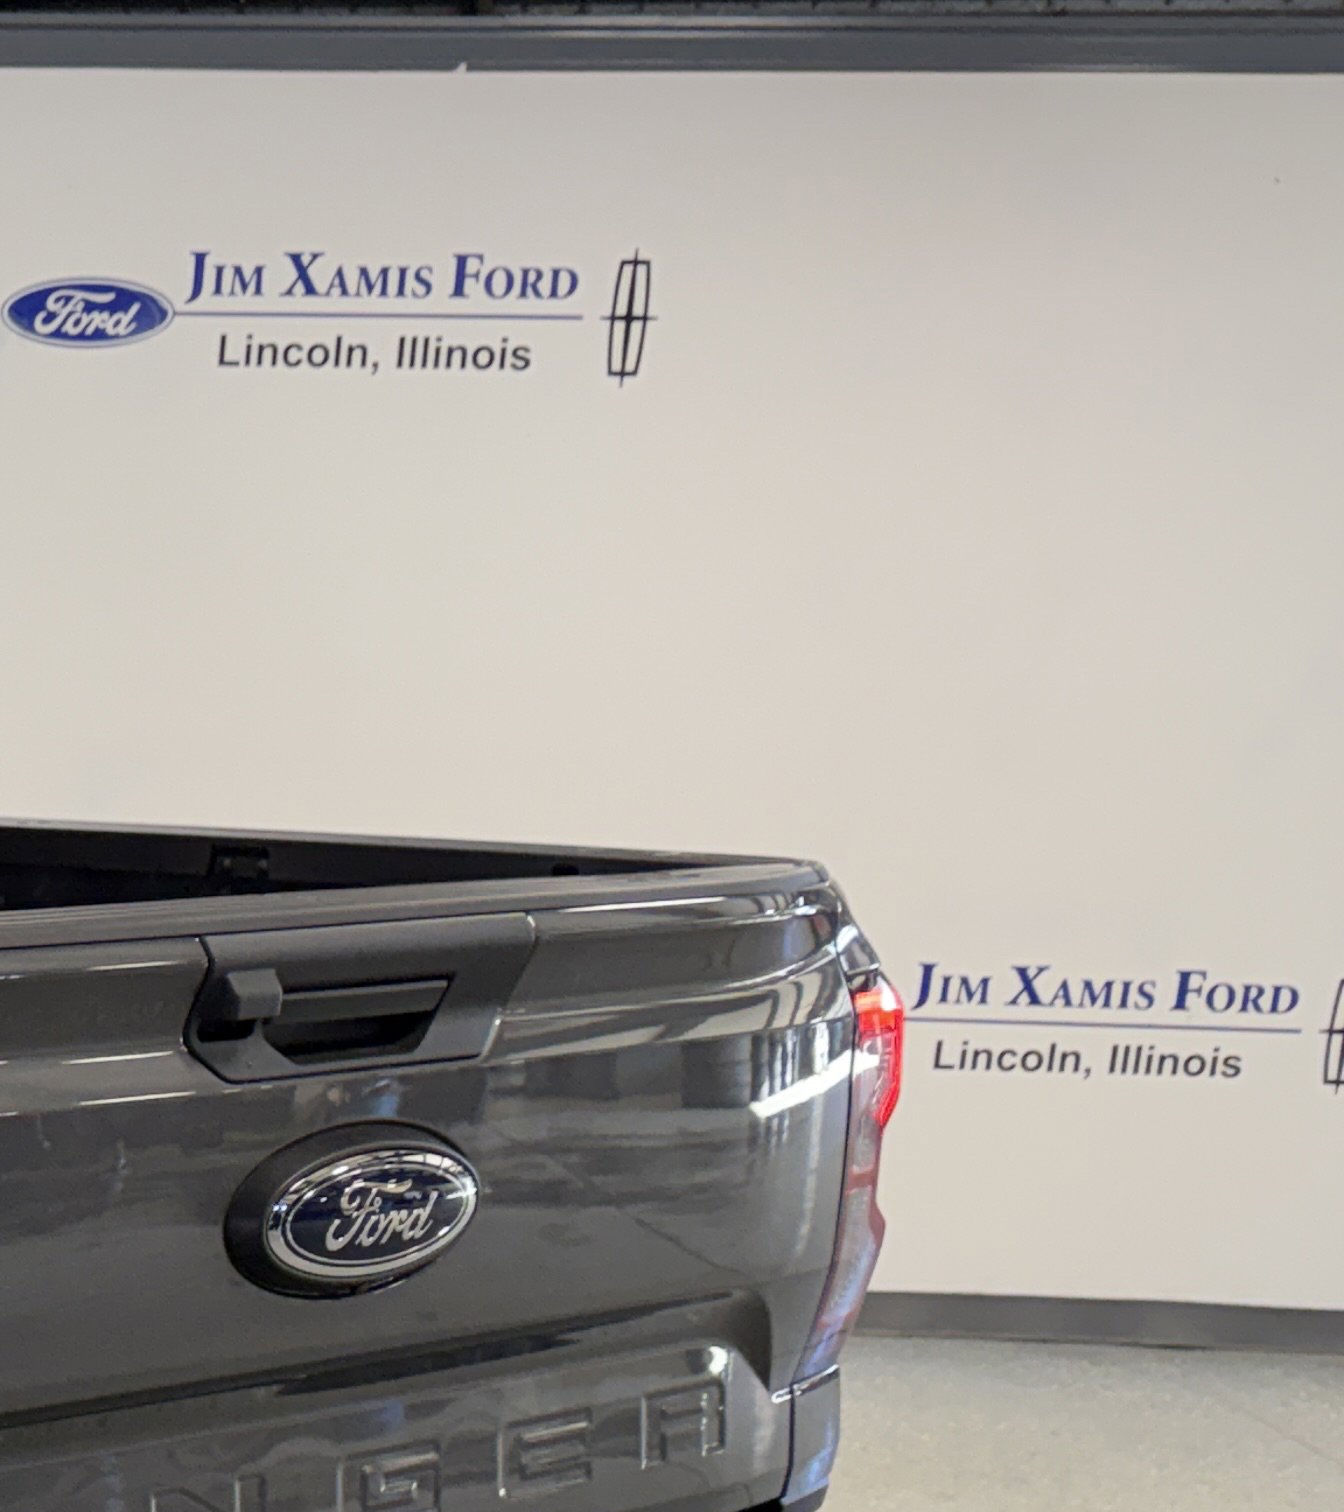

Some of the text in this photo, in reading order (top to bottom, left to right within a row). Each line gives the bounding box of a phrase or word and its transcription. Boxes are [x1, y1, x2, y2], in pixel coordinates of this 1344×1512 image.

[185, 251, 579, 303] JIM XAMIS FORD
[33, 288, 141, 339] Ford
[217, 333, 531, 375] Lincoln, Illinois
[910, 962, 1300, 1015] JIM XAMIS FORD
[933, 1039, 1242, 1080] Lincoln, Illinois
[325, 1178, 439, 1252] Ford
